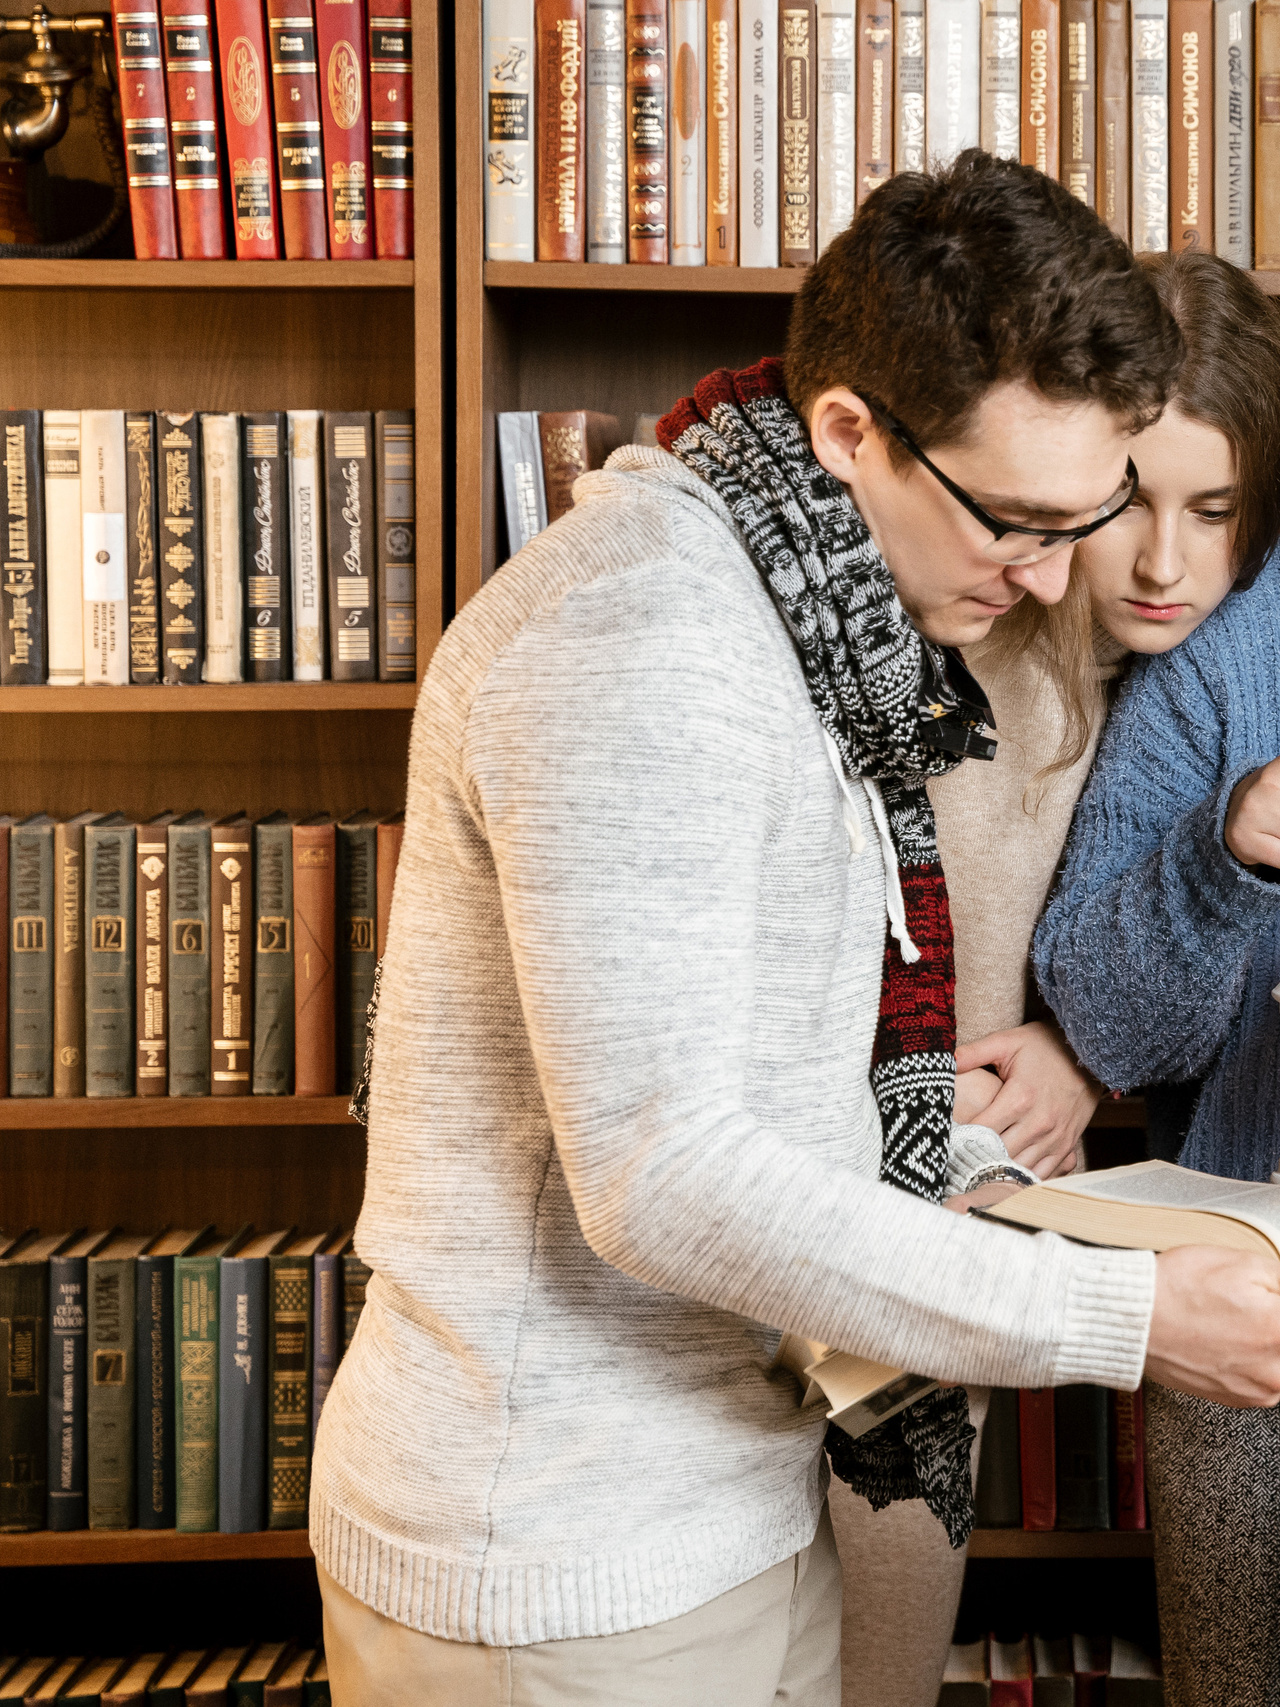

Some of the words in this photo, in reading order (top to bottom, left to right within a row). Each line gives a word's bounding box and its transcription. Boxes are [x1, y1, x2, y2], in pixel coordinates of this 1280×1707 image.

[712, 19, 729, 119] СИМОНОВ
[753, 47, 764, 87] ДЮМА
[946, 20, 962, 110] СКАРЛЕТТ
[1030, 29, 1048, 126] СИМОНОВ
[1182, 31, 1199, 130] СИМОНОВ
[136, 83, 145, 97] 7
[186, 86, 195, 101] 2
[291, 87, 301, 101] 5
[387, 88, 397, 102] 6
[560, 137, 576, 153] И
[753, 94, 764, 165] АЛЕКСАНДР
[1072, 93, 1083, 160] РАССКАЗЫ
[681, 155, 693, 176] 2
[1229, 132, 1242, 217] ШУЛЬГИН
[555, 155, 576, 233] КИРИЛЛ
[717, 226, 726, 249] 1
[253, 458, 273, 526] Стейнбек
[341, 459, 362, 527] Стейнбек
[8, 519, 29, 561] АННА
[253, 526, 274, 576] Джон
[342, 525, 362, 576] Джон
[8, 569, 33, 584] 1-2
[344, 610, 363, 627] 5
[17, 841, 41, 911] БАЛЬЗАК
[96, 841, 120, 909] БАЛЬЗАК
[175, 843, 199, 912] БАЛЬЗАК
[64, 866, 79, 954] КОПТЯЕВА
[21, 923, 38, 946] 11
[100, 922, 119, 947] 12
[182, 924, 196, 951] 6
[303, 952, 310, 979] 1
[146, 1050, 159, 1067] 2
[226, 1050, 237, 1070] 1
[96, 1274, 120, 1342] БАЛЬЗАК
[104, 1354, 117, 1381] 7
